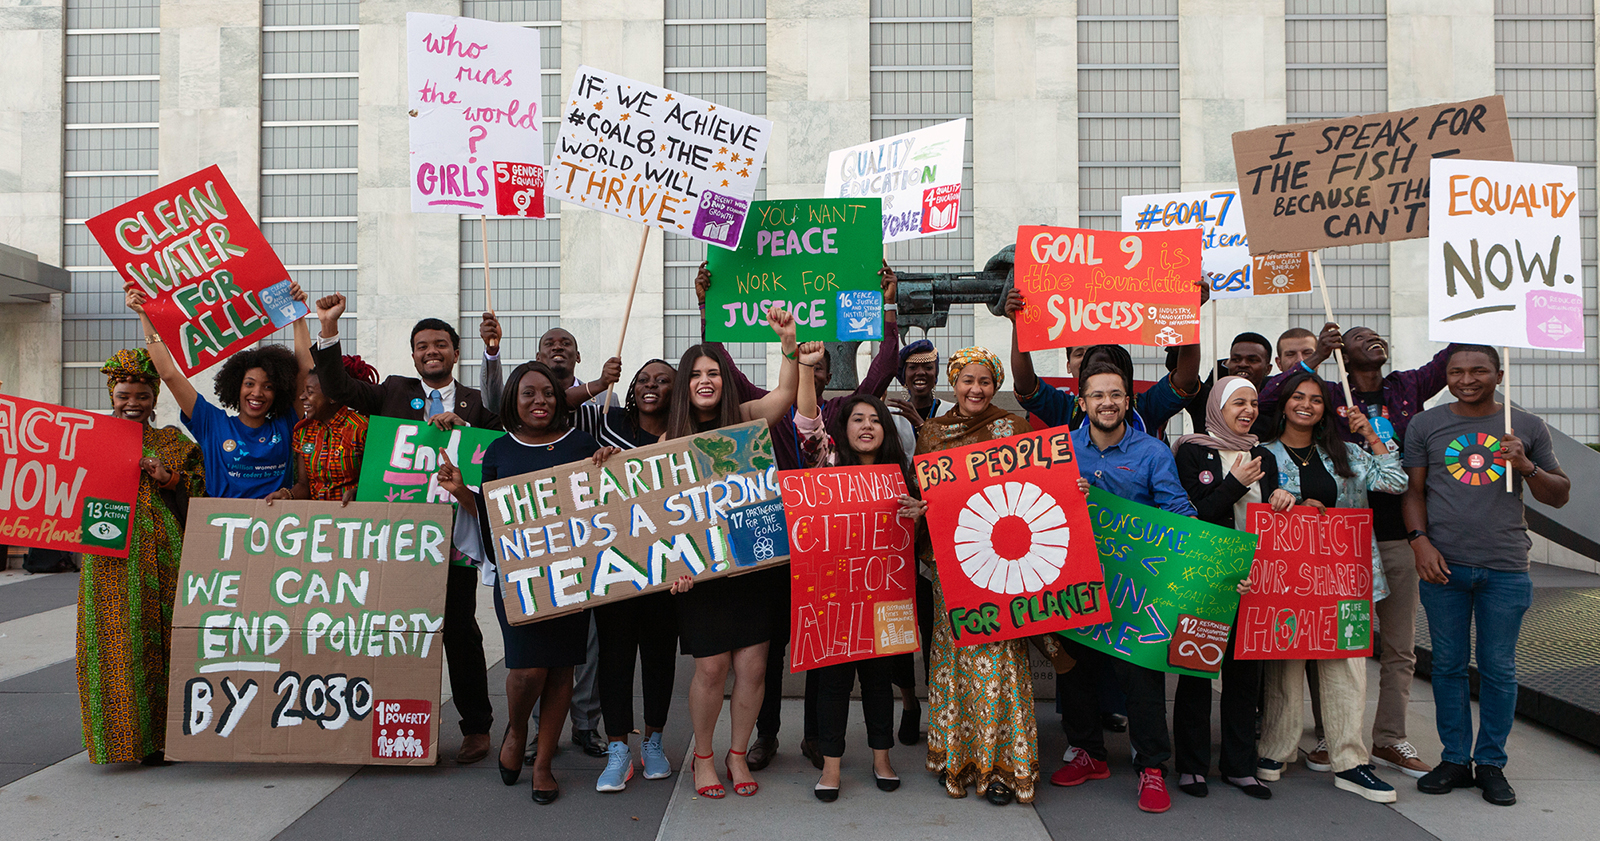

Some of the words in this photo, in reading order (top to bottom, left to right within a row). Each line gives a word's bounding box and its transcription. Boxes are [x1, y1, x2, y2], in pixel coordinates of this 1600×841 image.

[422, 24, 488, 58] who
[418, 79, 461, 104] the
[455, 66, 512, 86] runs
[462, 99, 538, 132] world
[578, 73, 604, 99] IF
[617, 85, 658, 118] WE
[664, 102, 761, 152] ACHIEVE
[1269, 132, 1295, 161] I
[1316, 116, 1418, 154] SPEAK
[1427, 104, 1486, 140] FOR
[562, 136, 634, 170] WORLD
[645, 161, 698, 198] WILL
[667, 135, 713, 170] THE
[841, 137, 916, 182] QUALITY
[417, 162, 490, 197] GIRLS
[496, 164, 510, 184] 5
[511, 165, 543, 178] GENDER
[511, 175, 544, 188] EQUALITY
[840, 164, 937, 198] EDUCATION
[1246, 160, 1310, 195] THE
[1327, 142, 1417, 184] FISH
[561, 160, 681, 224] THRIVE
[700, 191, 712, 209] 8
[711, 200, 726, 210] AND
[924, 189, 936, 207] 4
[935, 193, 960, 204] EDUCATION
[936, 185, 960, 195] QUALITY
[1273, 186, 1371, 216] BECAUSE
[1448, 174, 1576, 219] EQUALITY
[115, 180, 228, 255] CLEAN
[708, 207, 734, 220] GROWTH
[758, 205, 797, 227] YOU
[809, 204, 866, 225] WANT
[1135, 191, 1236, 230] #GOAL7
[757, 227, 838, 256] PEACE
[1030, 232, 1103, 266] GOAL
[1119, 235, 1143, 270] 9
[1160, 242, 1191, 270] is
[126, 223, 249, 299] WATER
[1255, 256, 1265, 270] 7
[1443, 235, 1575, 300] NOW.
[172, 269, 243, 320] FOR
[262, 290, 273, 304] 6
[270, 281, 287, 293] CLEAN
[736, 271, 787, 294] WORK
[802, 270, 840, 295] FOR
[1022, 264, 1074, 294] the
[1085, 266, 1201, 302] foundation
[273, 295, 284, 304] AND
[839, 293, 852, 308] 16
[1147, 306, 1157, 320] 9
[1532, 295, 1547, 308] 10
[179, 290, 270, 369] ALL!
[1020, 298, 1041, 324] to
[1047, 293, 1144, 342] SUCCESS
[390, 424, 461, 472] End
[916, 456, 957, 492] FOR
[965, 432, 1072, 482] PEOPLE
[488, 476, 562, 525] THE
[568, 450, 700, 512] EARTH
[783, 471, 908, 508] SUSTAINABLE
[87, 502, 102, 518] 13
[104, 503, 131, 512] CLIMATE
[104, 510, 128, 520] ACTION
[499, 511, 618, 562] NEEDS
[629, 503, 658, 538] A
[663, 464, 781, 527] STRONG
[731, 511, 744, 529] 17
[745, 518, 758, 528] FOR
[762, 513, 776, 524] THE
[206, 513, 446, 566] TOGETHER
[754, 523, 782, 538] GOALS
[791, 506, 910, 552] CITIES
[1255, 511, 1370, 556] PROTECT
[505, 525, 730, 616] TEAM!
[848, 554, 906, 592] FOR
[1182, 557, 1247, 582] #GOAL12
[1250, 559, 1289, 594] OUR
[1294, 563, 1370, 596] SHARED
[183, 570, 242, 608] WE
[270, 567, 369, 608] CAN
[1167, 582, 1218, 604] #GOAL12
[877, 606, 886, 622] 11
[949, 602, 1001, 640] FOR
[1009, 581, 1104, 628] PLANET
[1341, 603, 1350, 620] 15
[1351, 603, 1362, 611] LIFE
[198, 609, 291, 659] END
[301, 608, 444, 659] POVERTY
[793, 601, 874, 668] ALL
[1180, 617, 1198, 634] 12
[1243, 605, 1337, 652] HOME
[1031, 672, 1053, 680] 988
[183, 676, 258, 738] BY
[271, 671, 374, 730] 2030
[375, 701, 384, 726] 1
[385, 703, 400, 713] NO
[385, 712, 430, 724] POVERTY
